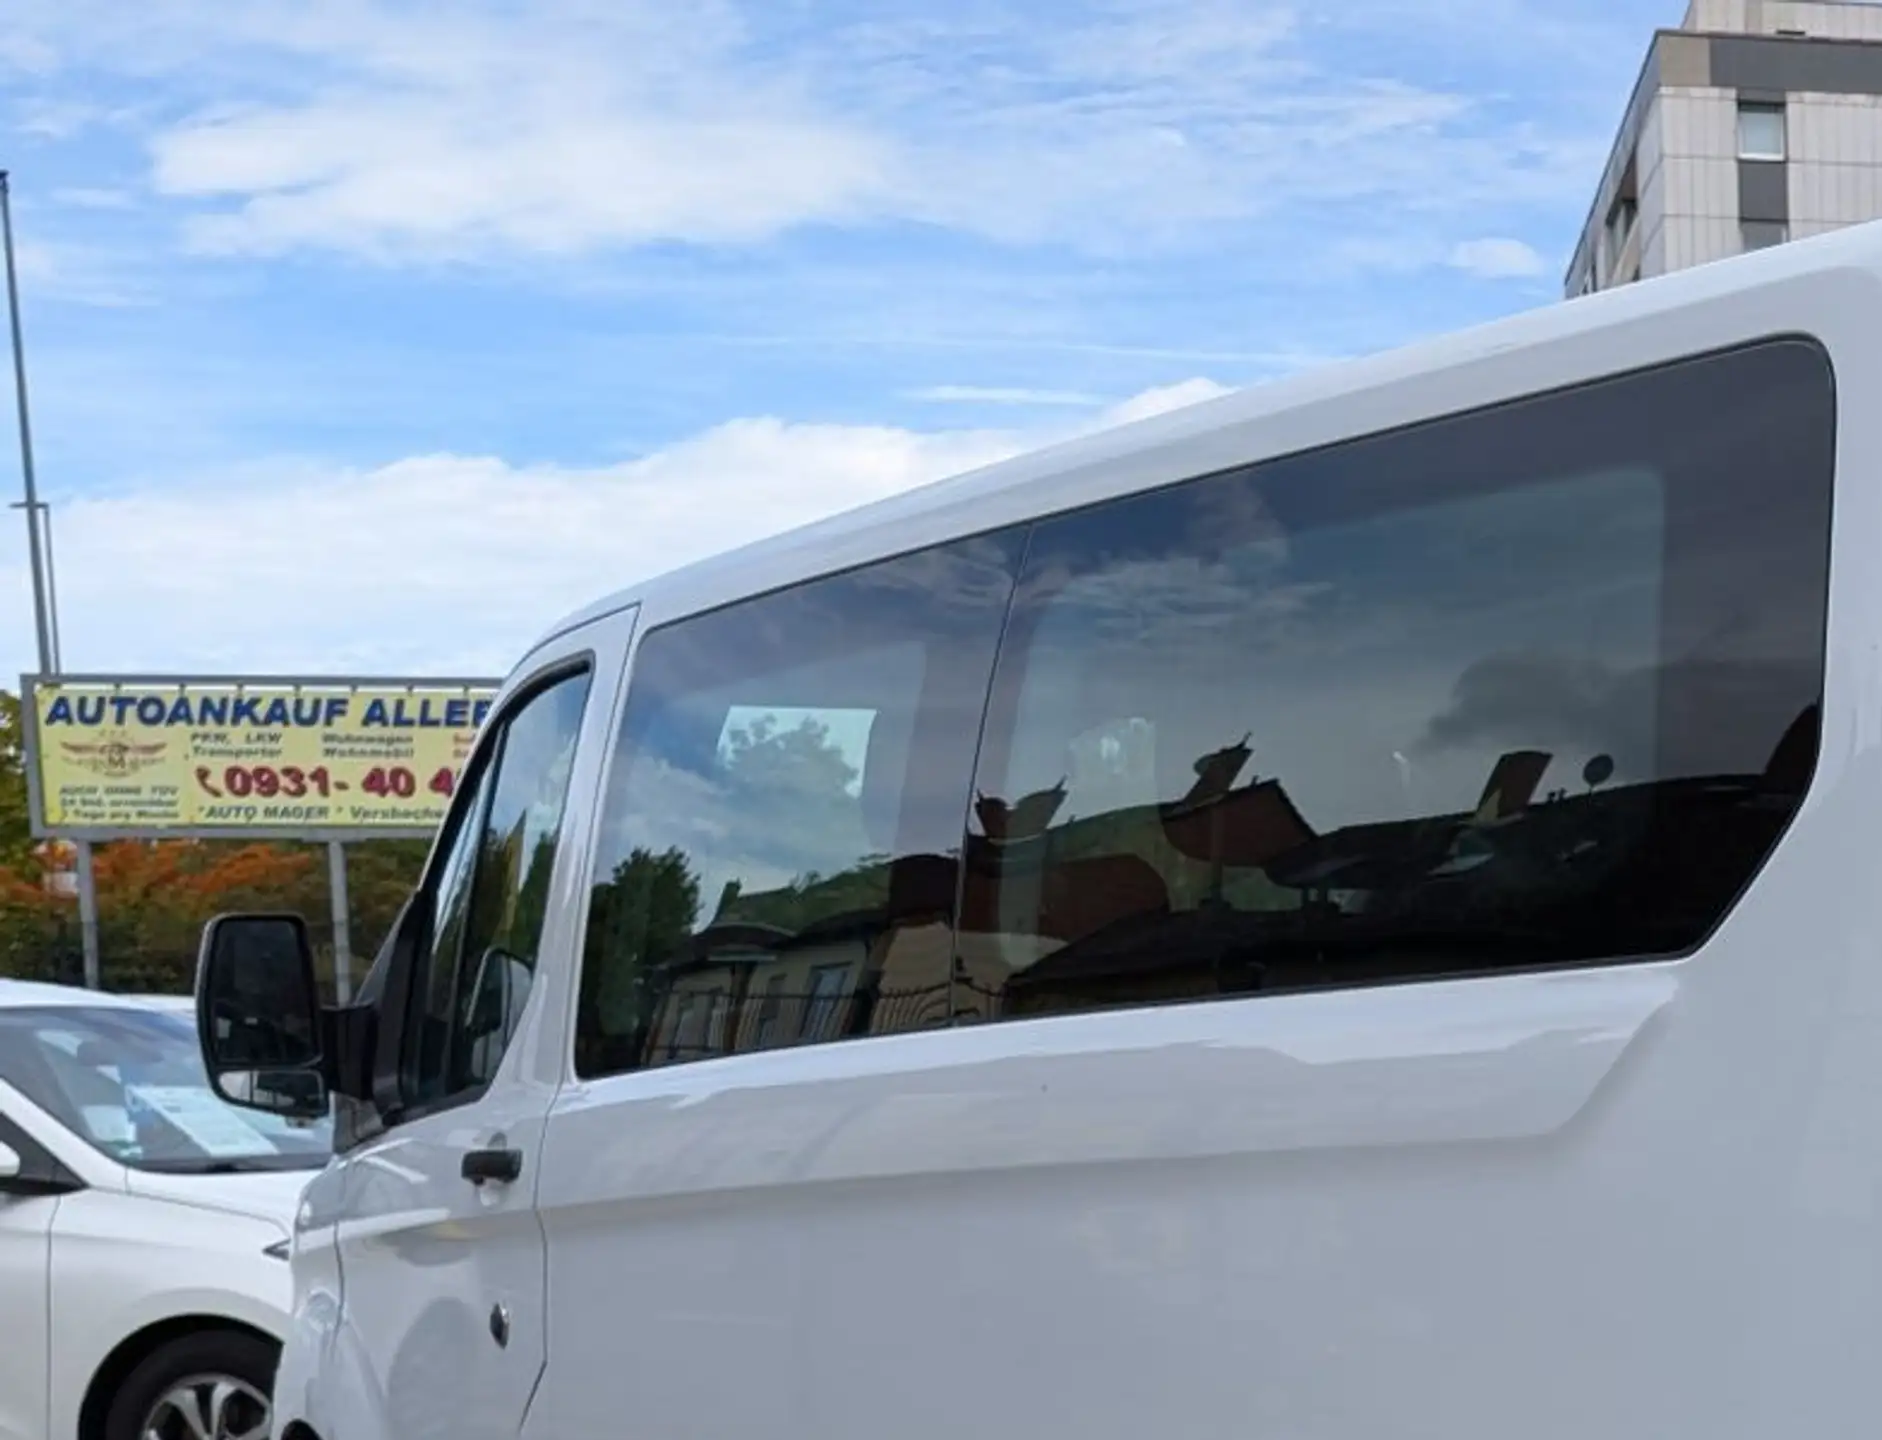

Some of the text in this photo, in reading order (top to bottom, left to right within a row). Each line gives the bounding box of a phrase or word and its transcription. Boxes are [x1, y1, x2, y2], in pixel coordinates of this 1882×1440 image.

[46, 696, 348, 727] AUTOANKAUF
[361, 766, 416, 798] 40
[428, 766, 459, 798] 4
